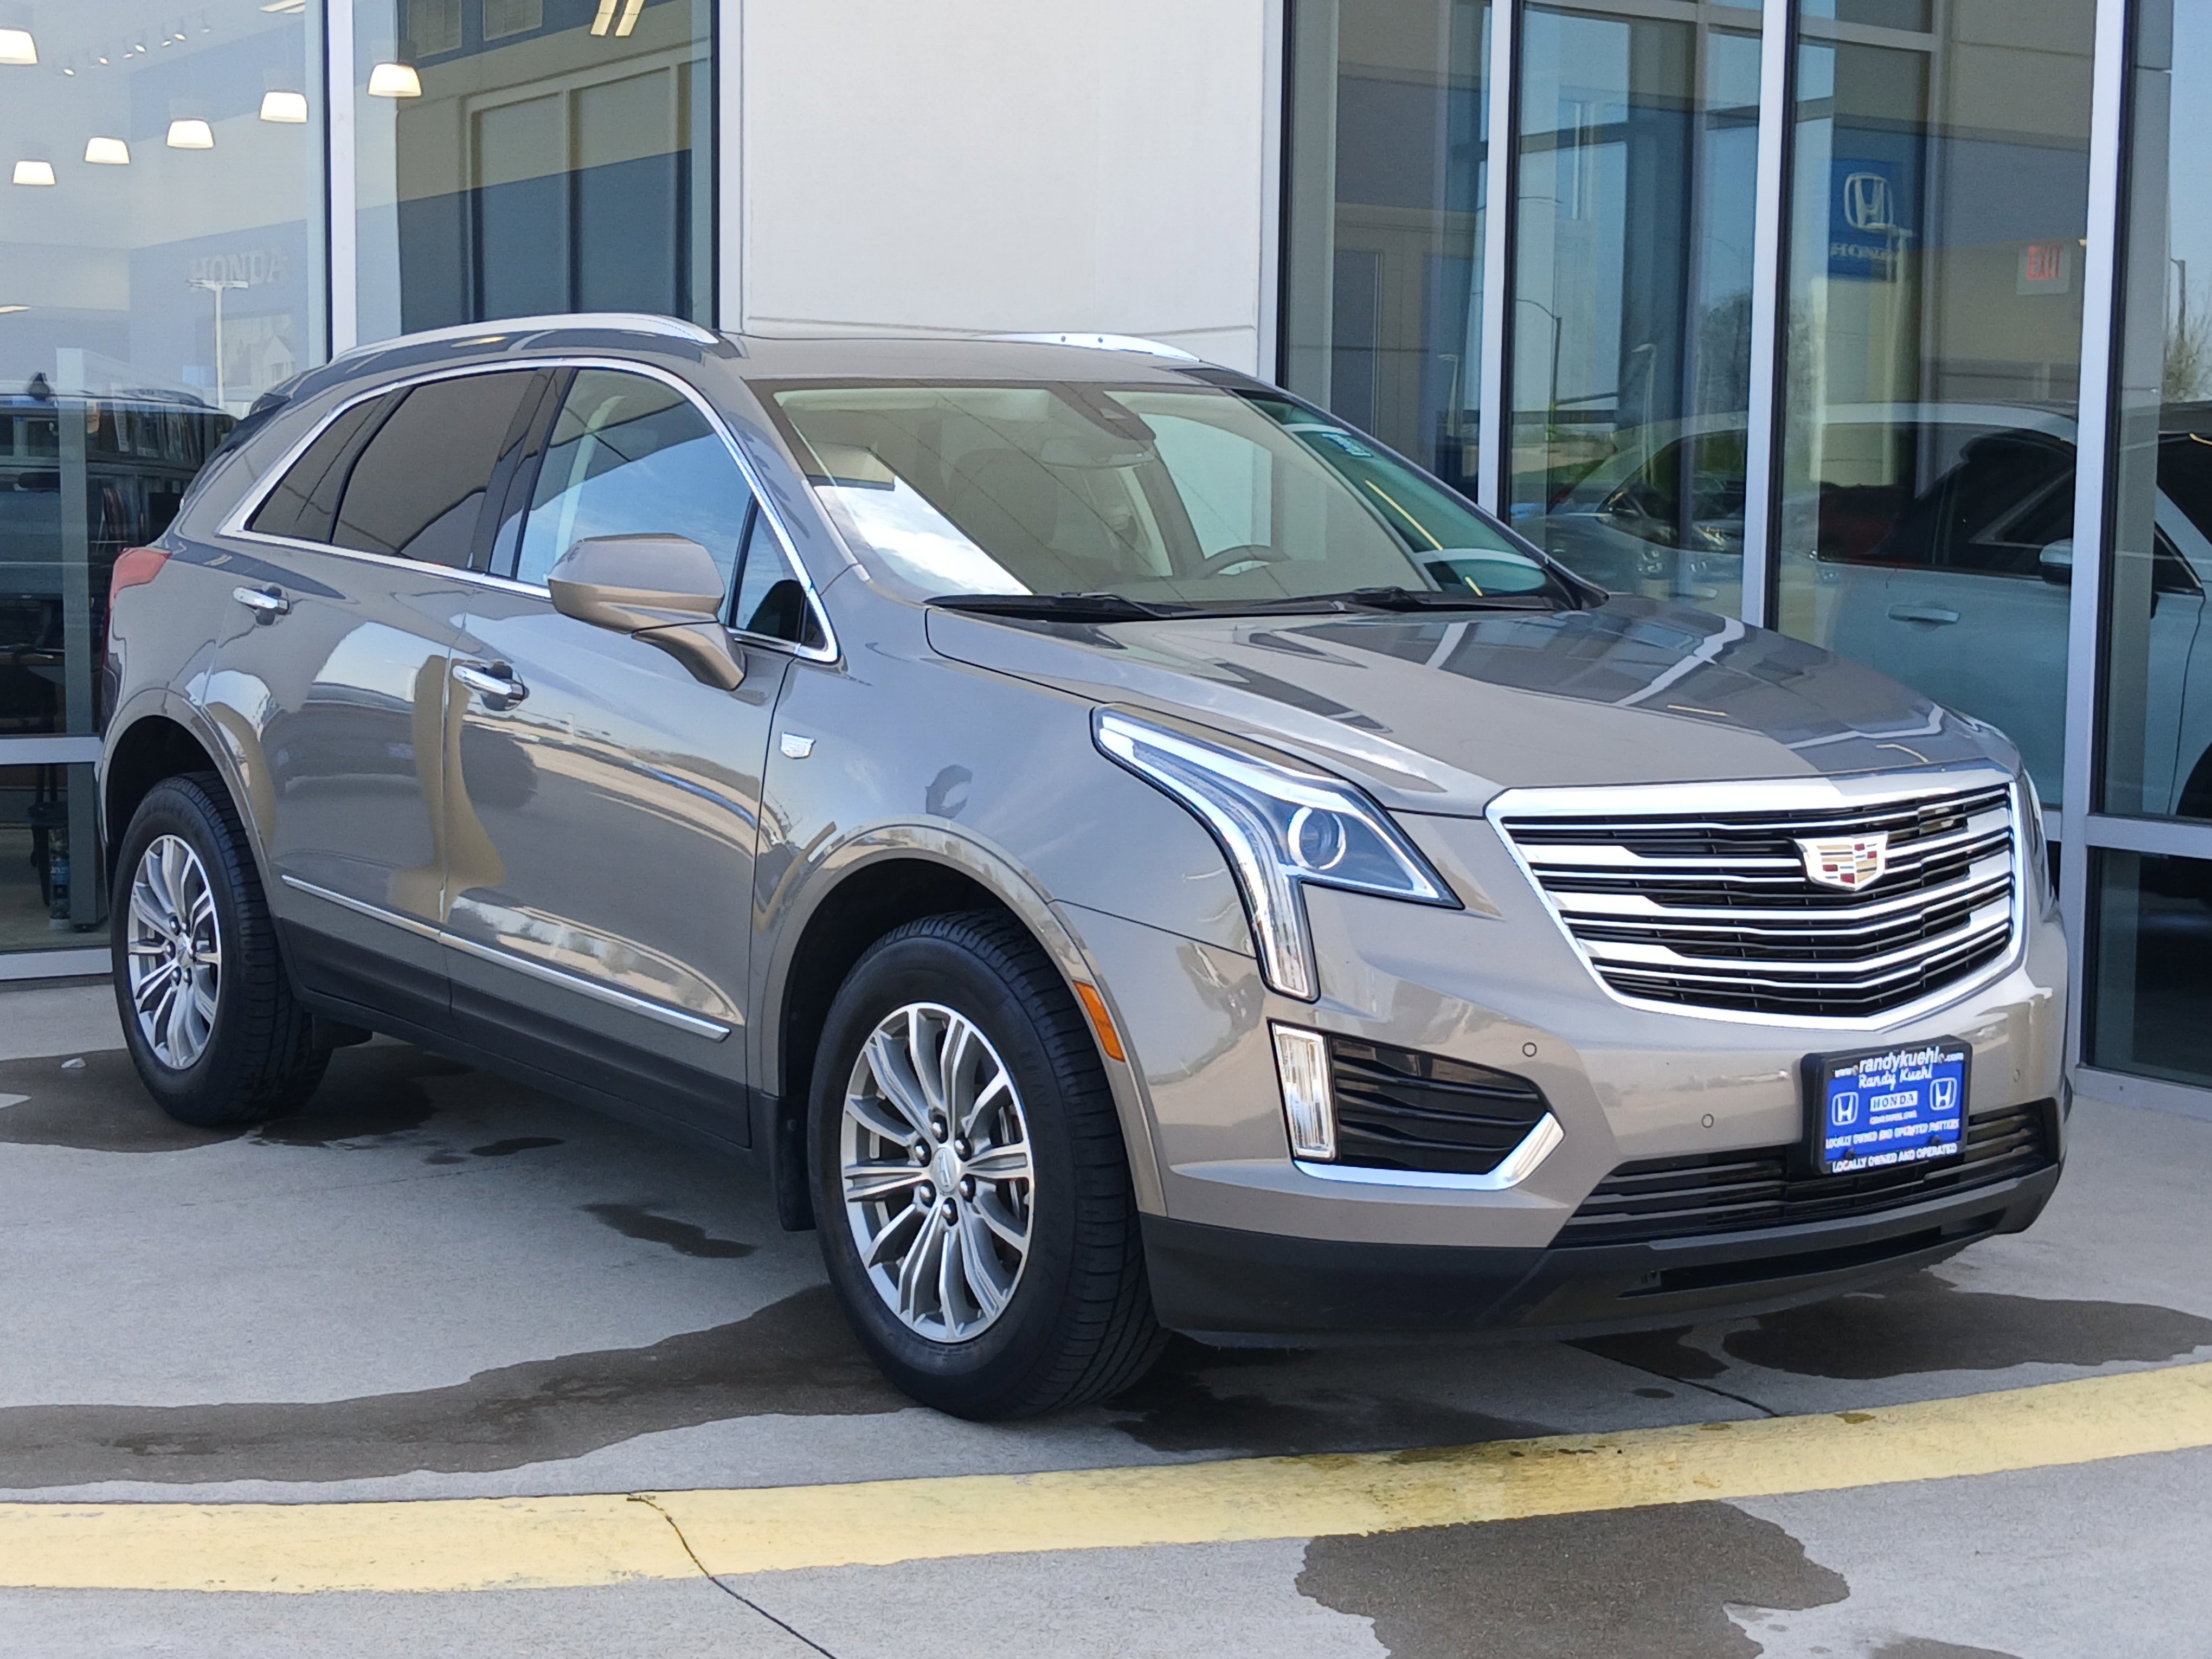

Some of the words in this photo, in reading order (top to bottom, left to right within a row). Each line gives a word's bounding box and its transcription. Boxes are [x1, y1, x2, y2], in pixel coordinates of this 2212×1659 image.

[190, 248, 289, 286] HONDA
[2027, 246, 2064, 280] EXIT
[1859, 1070, 1896, 1091] Randy
[1899, 1064, 1932, 1083] Kuehl
[1873, 1094, 1914, 1109] HONDA
[1825, 1135, 1852, 1149] LOCALLY
[1832, 1156, 1867, 1173] LOCALLY
[1868, 1153, 1898, 1167] OWNED
[1898, 1149, 1915, 1162] AND
[1916, 1142, 1958, 1159] OPERATED
